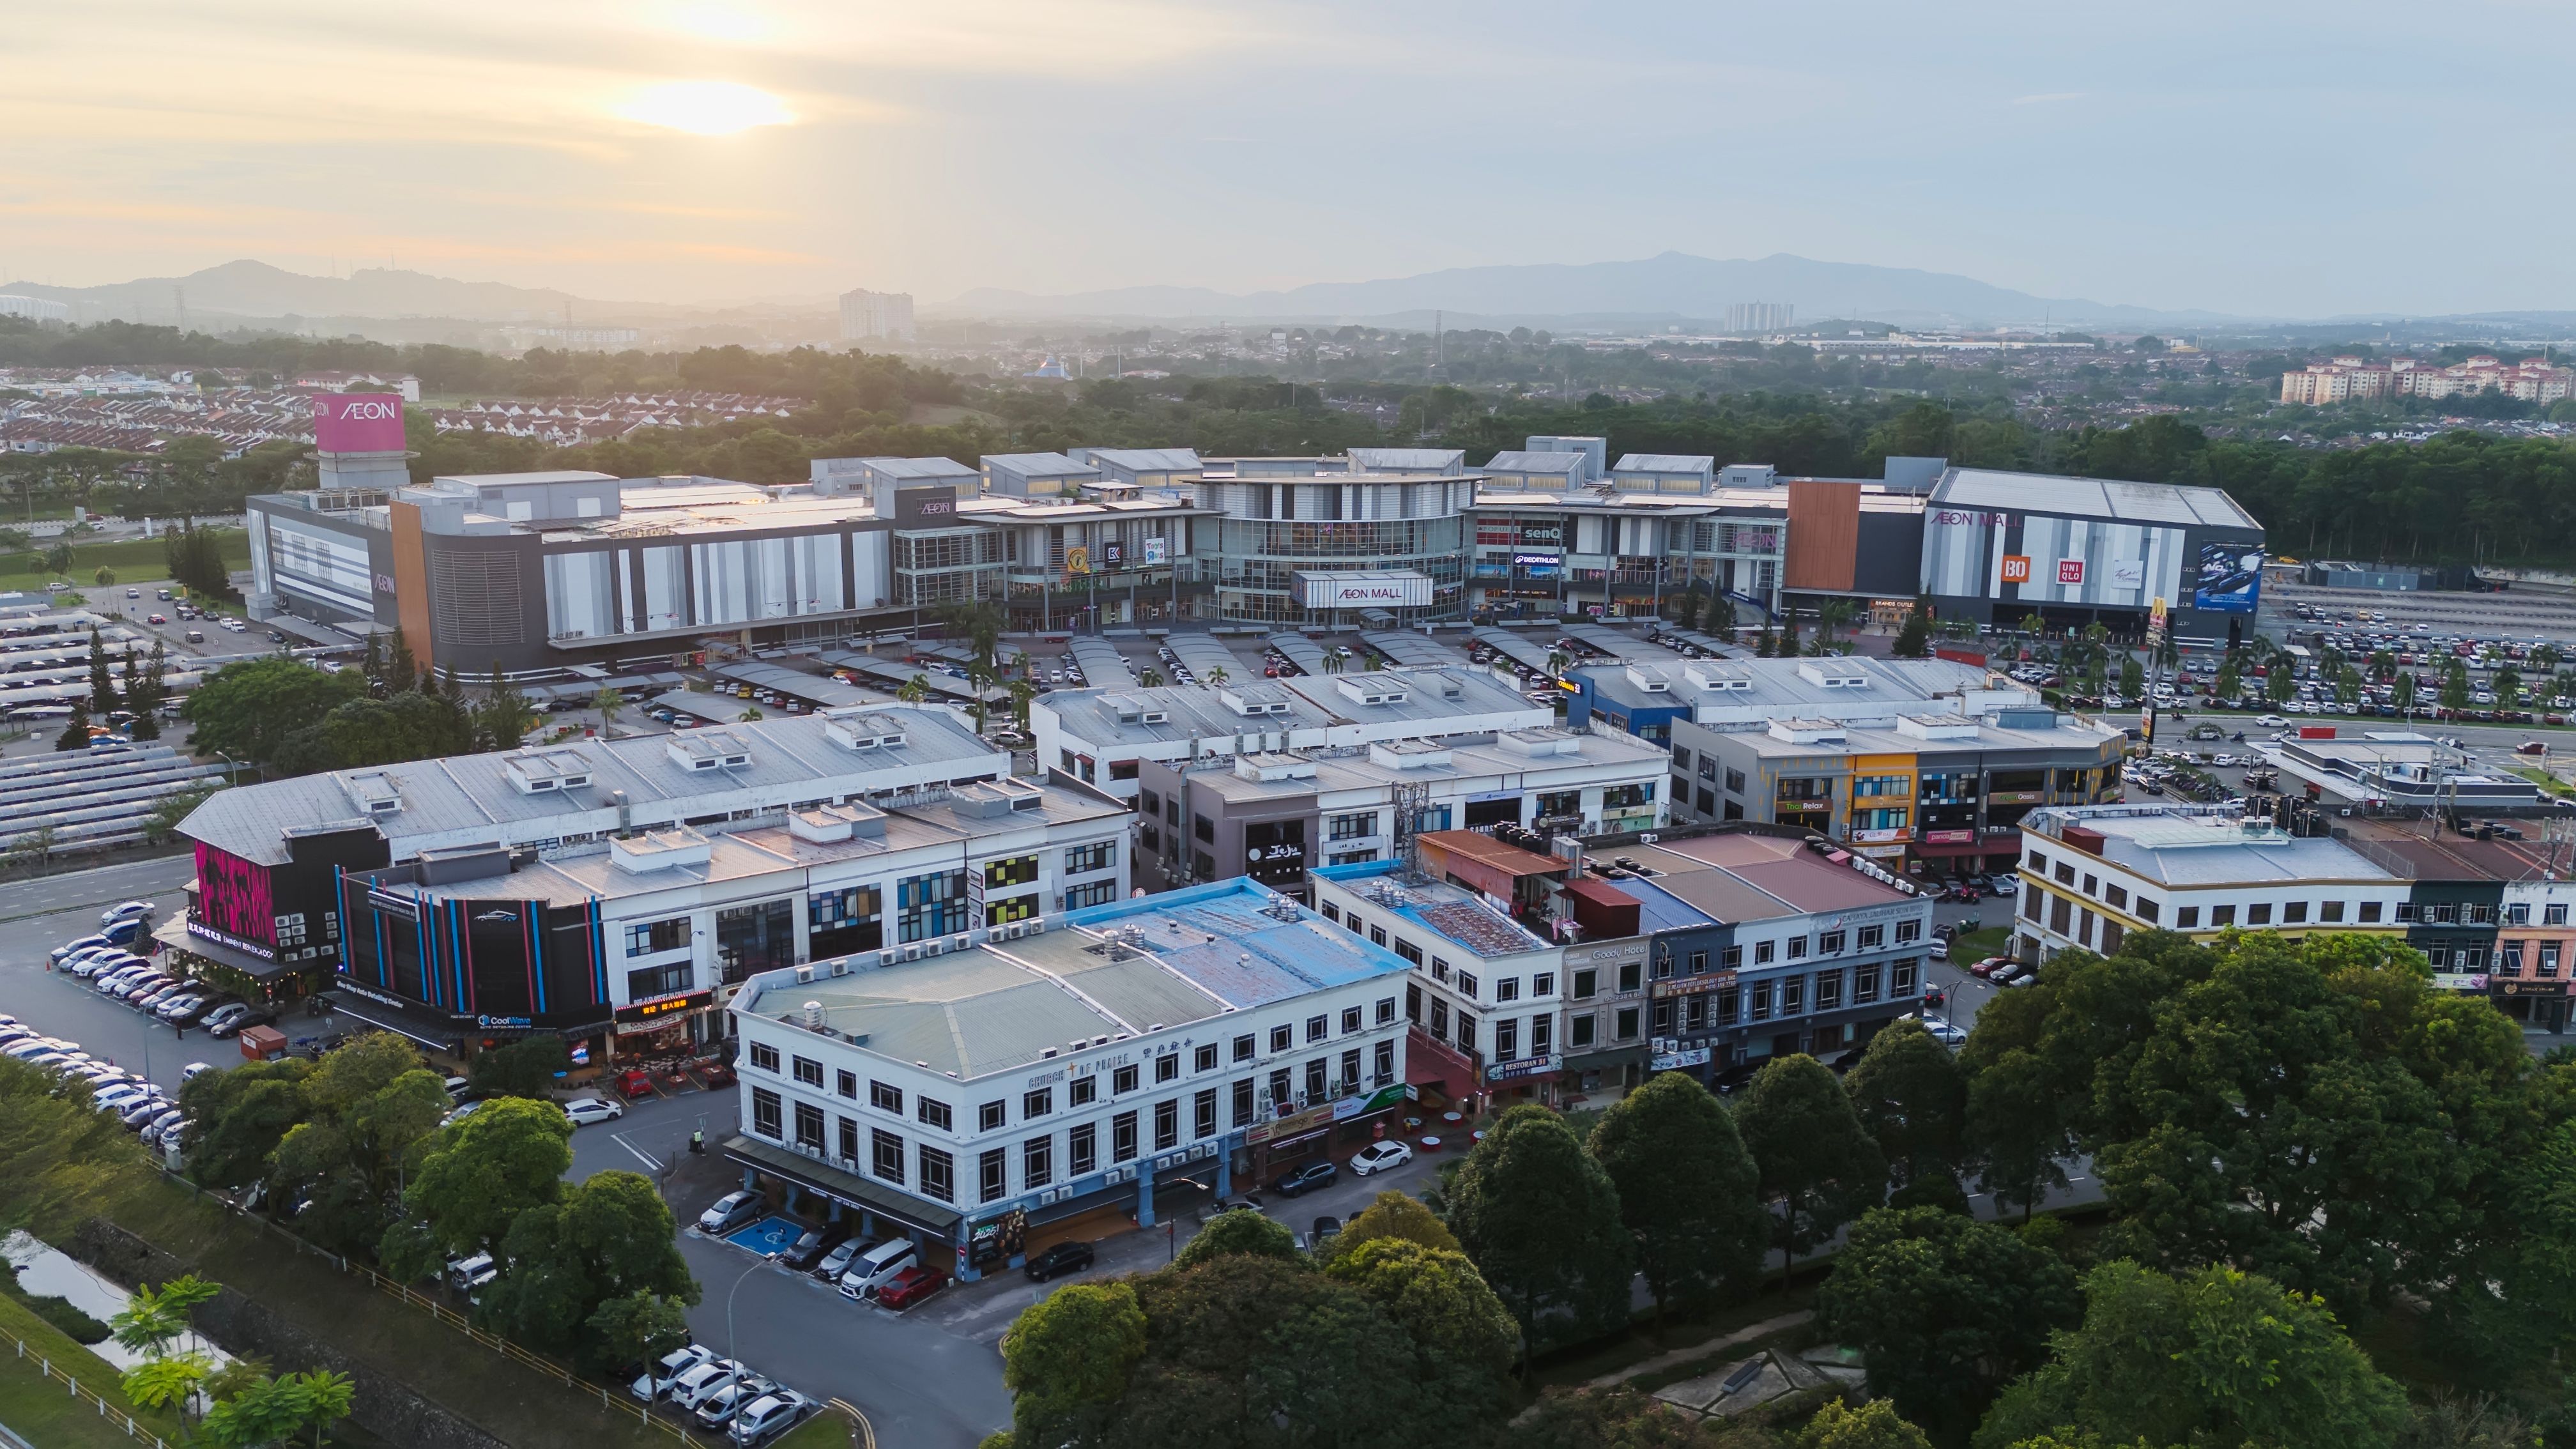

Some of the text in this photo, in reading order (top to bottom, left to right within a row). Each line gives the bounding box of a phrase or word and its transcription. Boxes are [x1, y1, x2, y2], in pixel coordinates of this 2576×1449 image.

[1979, 513, 2022, 527] MALL
[2005, 560, 2026, 577] BO
[2062, 572, 2080, 581] QLO
[1372, 588, 1402, 599] MALL
[1592, 946, 1648, 959] Goody Hotel
[491, 1016, 531, 1025] CoolWave
[1029, 1070, 1065, 1089] CHURCH
[1096, 1053, 1129, 1072] PRAISE
[1505, 1060, 1537, 1071] RESTORAN
[972, 1223, 1000, 1241] 2025!
